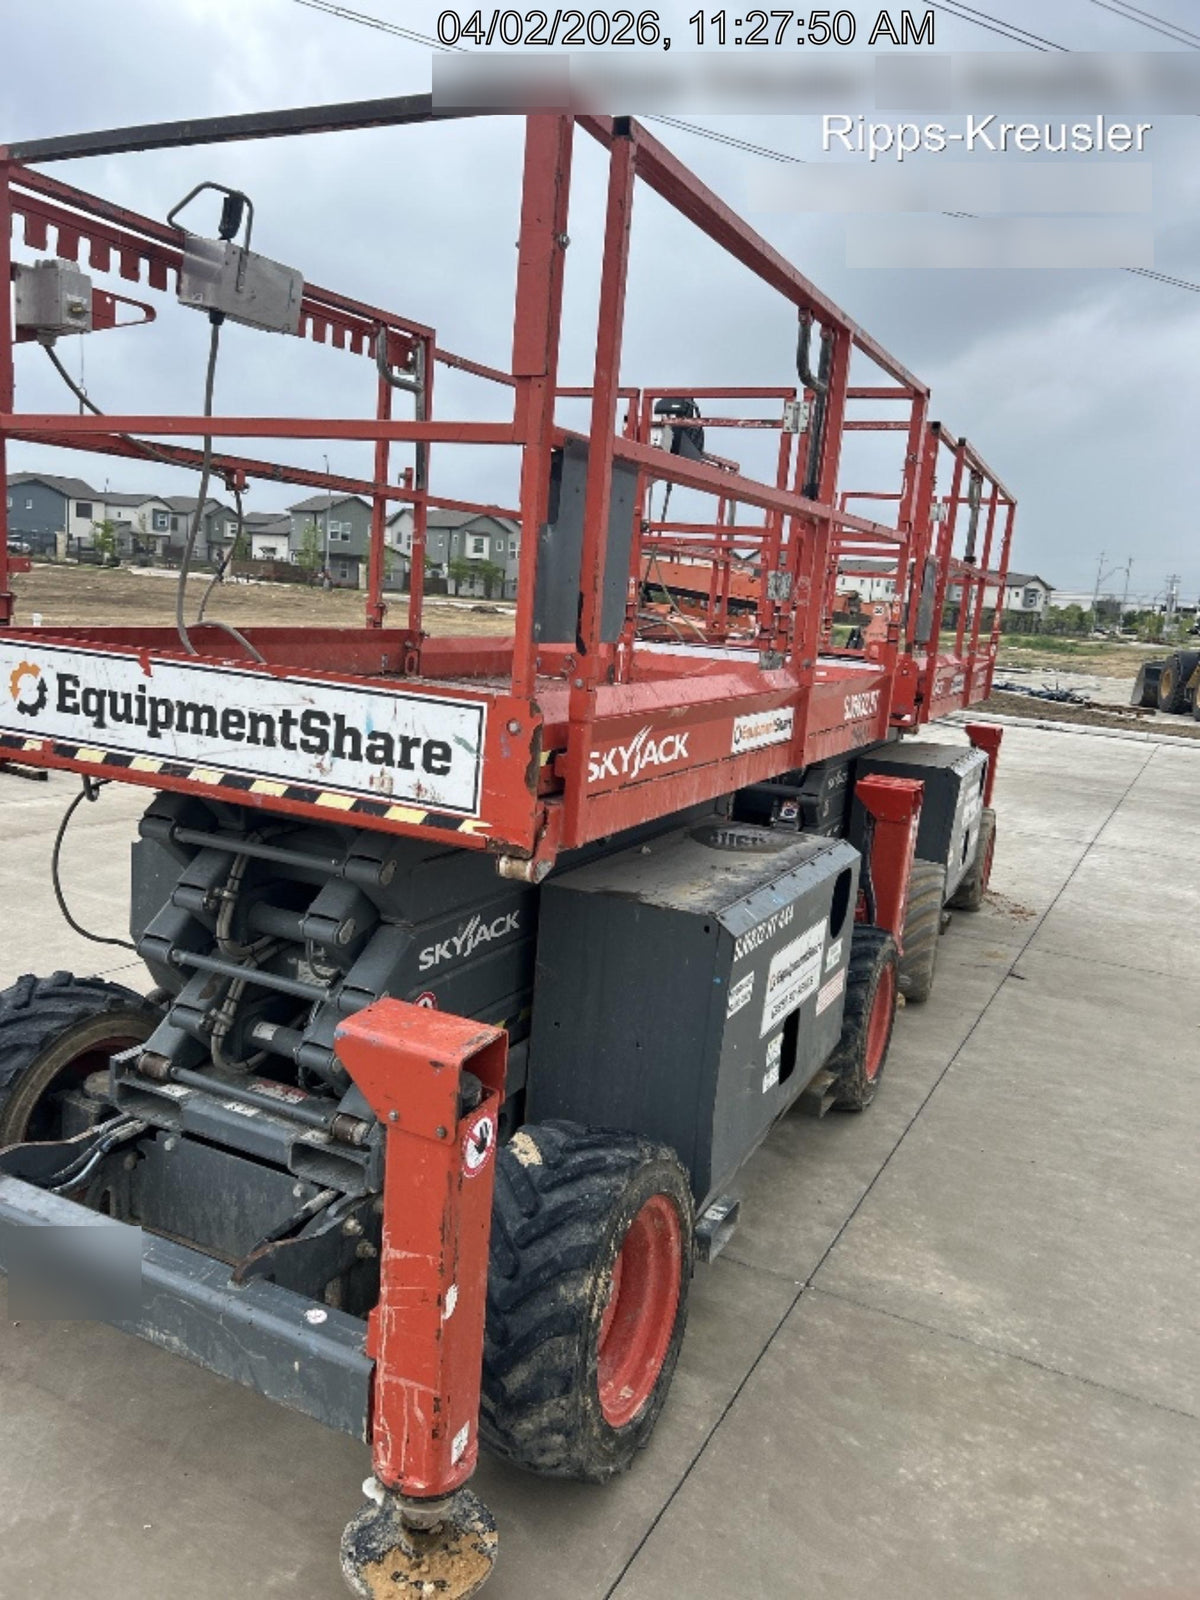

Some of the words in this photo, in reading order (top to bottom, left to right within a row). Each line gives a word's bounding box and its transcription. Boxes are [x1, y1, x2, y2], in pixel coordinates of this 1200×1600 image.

[56, 673, 453, 776] EquipmentShare
[587, 724, 689, 783] SKYJACK
[418, 909, 520, 971] SKYJACK
